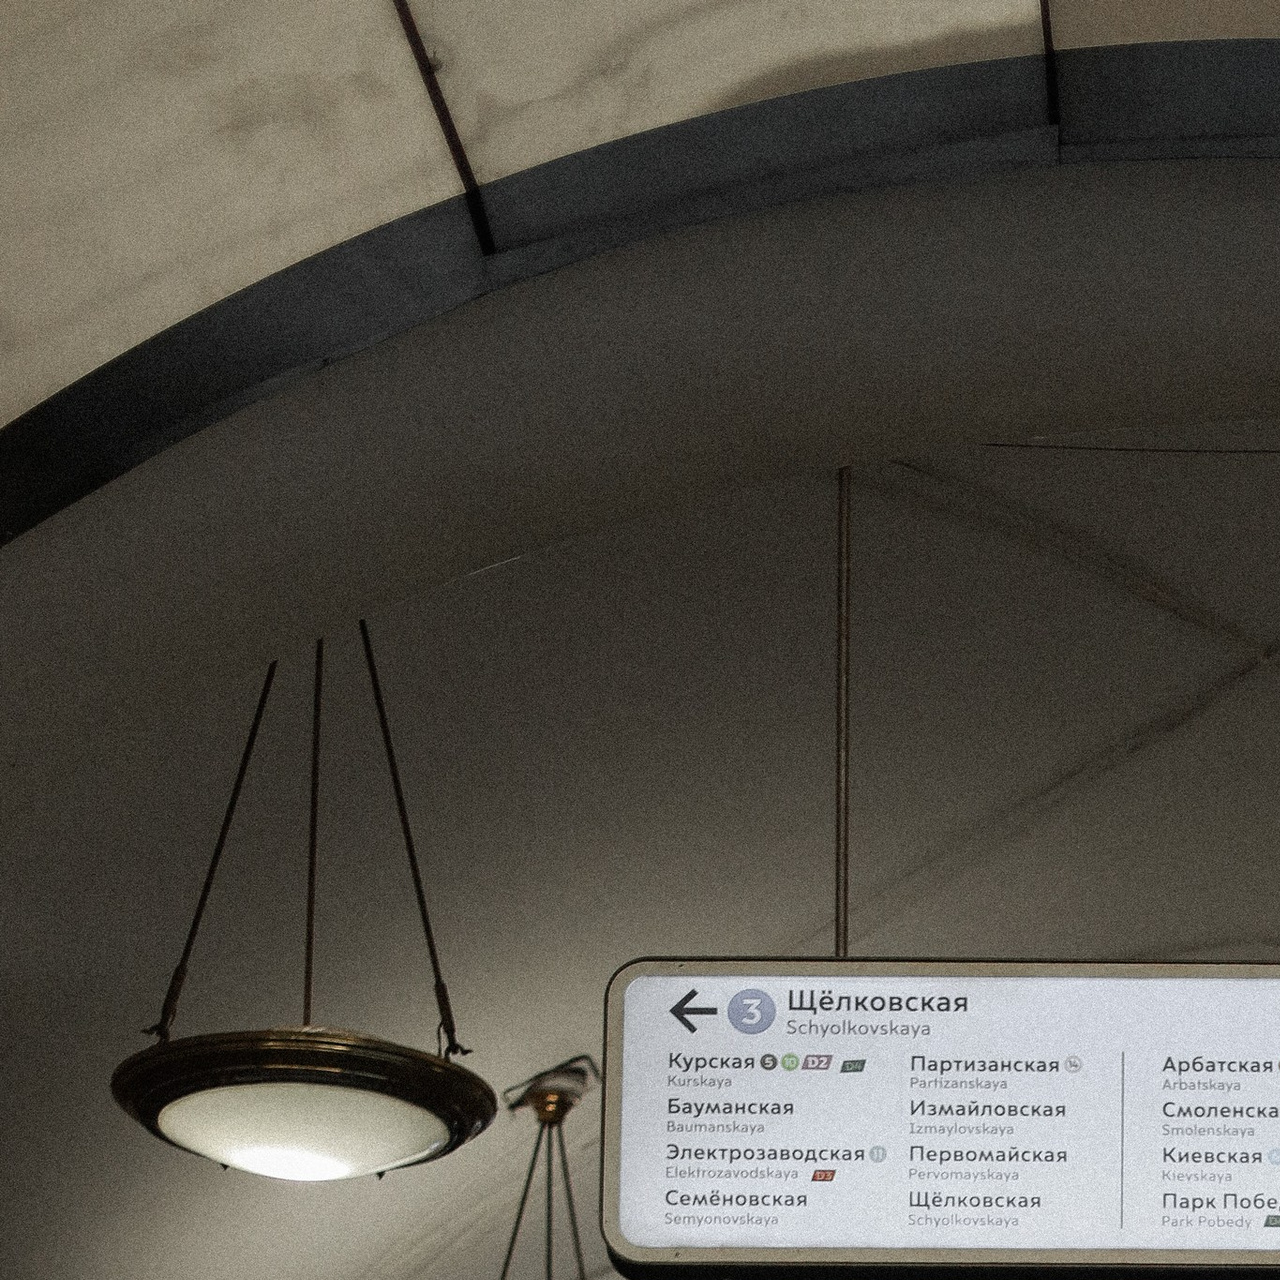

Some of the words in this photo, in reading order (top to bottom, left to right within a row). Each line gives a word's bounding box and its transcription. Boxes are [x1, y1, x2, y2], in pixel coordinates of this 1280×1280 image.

[742, 999, 762, 1024] 3
[788, 989, 969, 1016] Щёлковская
[786, 1020, 931, 1038] Schyolkovskaya
[668, 1054, 755, 1072] Курская
[807, 1057, 828, 1068] D2
[911, 1056, 1060, 1075] Партизанская
[1162, 1057, 1273, 1076] Арбатская
[667, 1075, 732, 1089] Kurskaya
[910, 1078, 1007, 1091] Partizanskaya
[1162, 1080, 1241, 1095] Arbatskaya
[668, 1099, 794, 1118] Бауманская
[910, 1101, 1066, 1118] Измайловская
[667, 1121, 765, 1135] Baumanskaya
[910, 1124, 1014, 1137] Izmaylovskaya
[1162, 1125, 1255, 1139] Smolenskaya
[666, 1146, 865, 1163] Электрозаводская
[909, 1146, 1067, 1164] Первомайская
[1162, 1148, 1262, 1163] Киевская
[666, 1167, 799, 1181] Elektrozavodskaya
[909, 1169, 1019, 1183] Pervomayskaya
[1162, 1170, 1232, 1185] Kievskaya
[665, 1191, 808, 1208] Семёновская
[909, 1192, 1041, 1211] Щёлковская
[1162, 1194, 1216, 1213] Парк
[664, 1213, 778, 1227] Semyonovskaya
[908, 1214, 1019, 1228] Schyolkovskaya
[1162, 1216, 1193, 1228] Park
[1199, 1215, 1252, 1230] Pobedy
